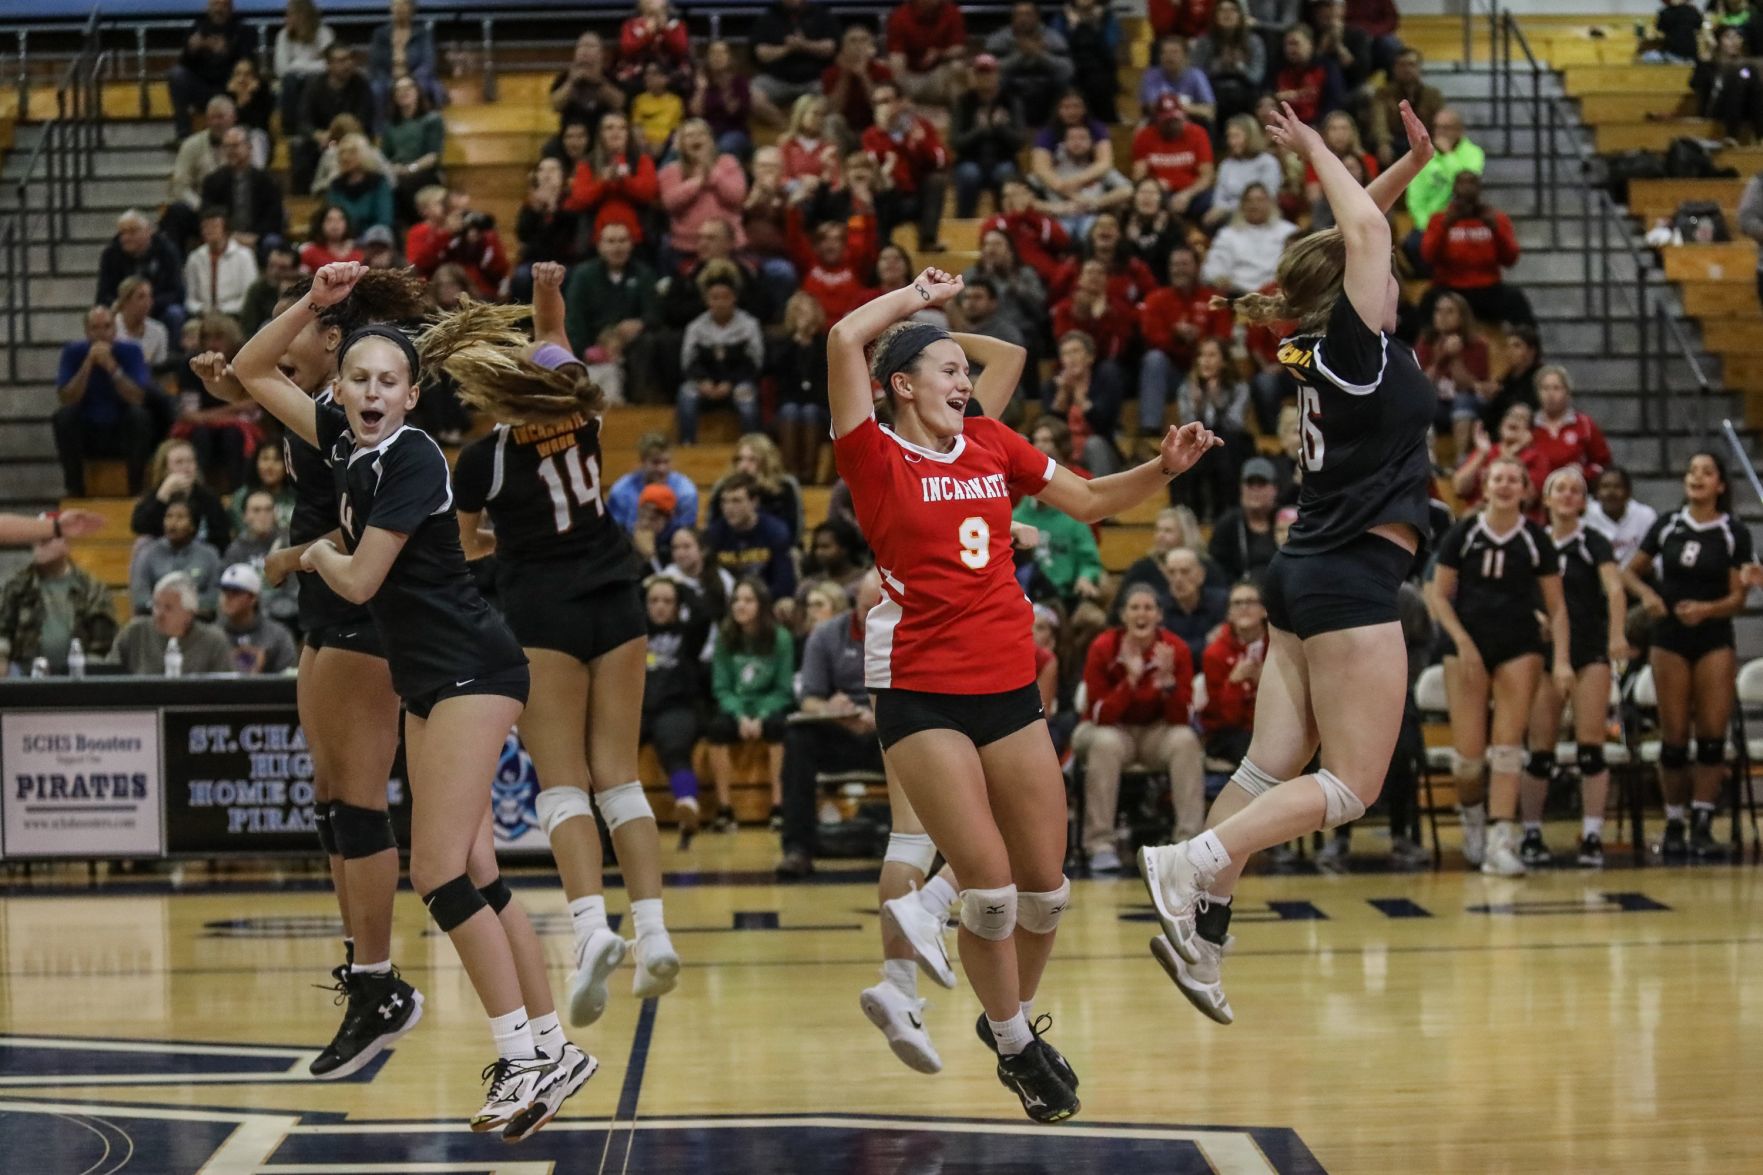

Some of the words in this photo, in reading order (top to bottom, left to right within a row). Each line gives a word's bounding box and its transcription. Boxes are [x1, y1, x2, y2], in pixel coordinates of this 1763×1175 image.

[537, 445, 605, 533] 14
[921, 473, 1009, 502] INCARNATE
[959, 516, 990, 569] 9
[1681, 540, 1701, 567] 8
[1482, 549, 1505, 578] 11
[75, 734, 141, 752] Boosters
[188, 725, 238, 753] ST.
[249, 753, 314, 779] HIG
[16, 773, 148, 799] PIRATES
[188, 779, 286, 807] HOME
[289, 780, 315, 805] O
[227, 806, 318, 833] PIRAT
